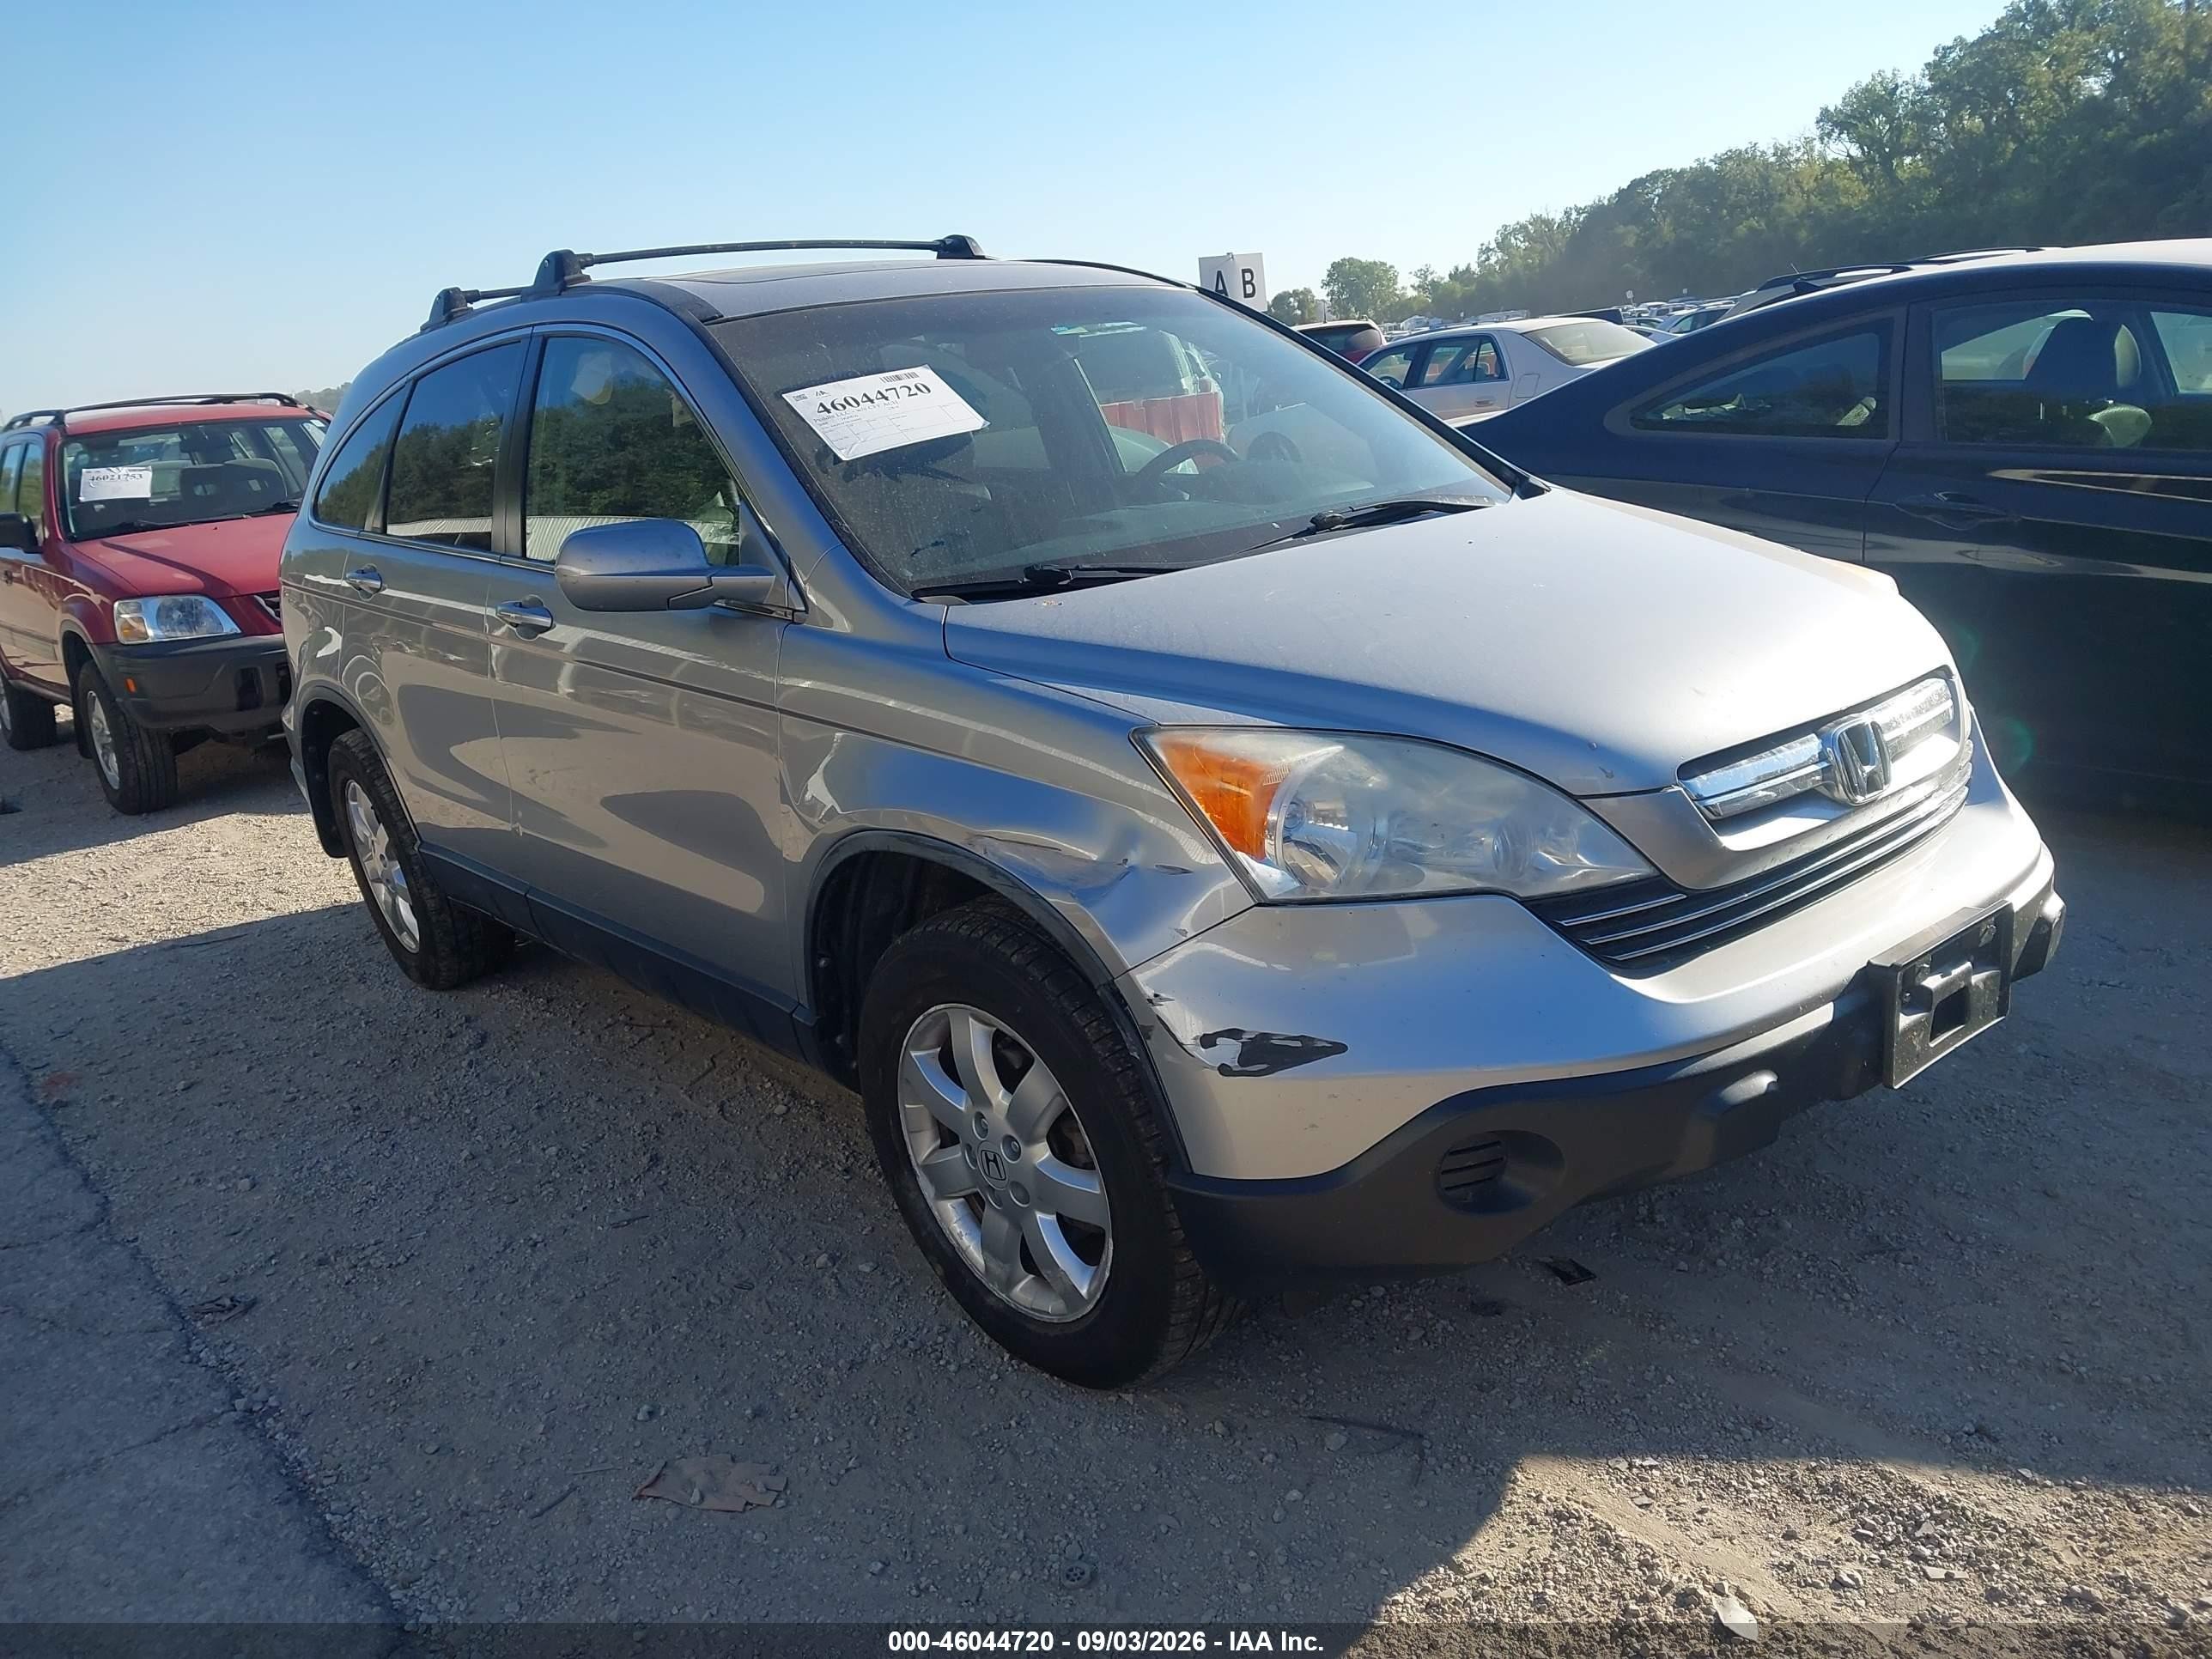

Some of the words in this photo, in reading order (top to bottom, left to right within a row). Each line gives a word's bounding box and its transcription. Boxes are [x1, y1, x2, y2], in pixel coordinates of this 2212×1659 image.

[1215, 270, 1229, 297] A
[1241, 268, 1256, 299] B
[817, 382, 932, 414] 46044720
